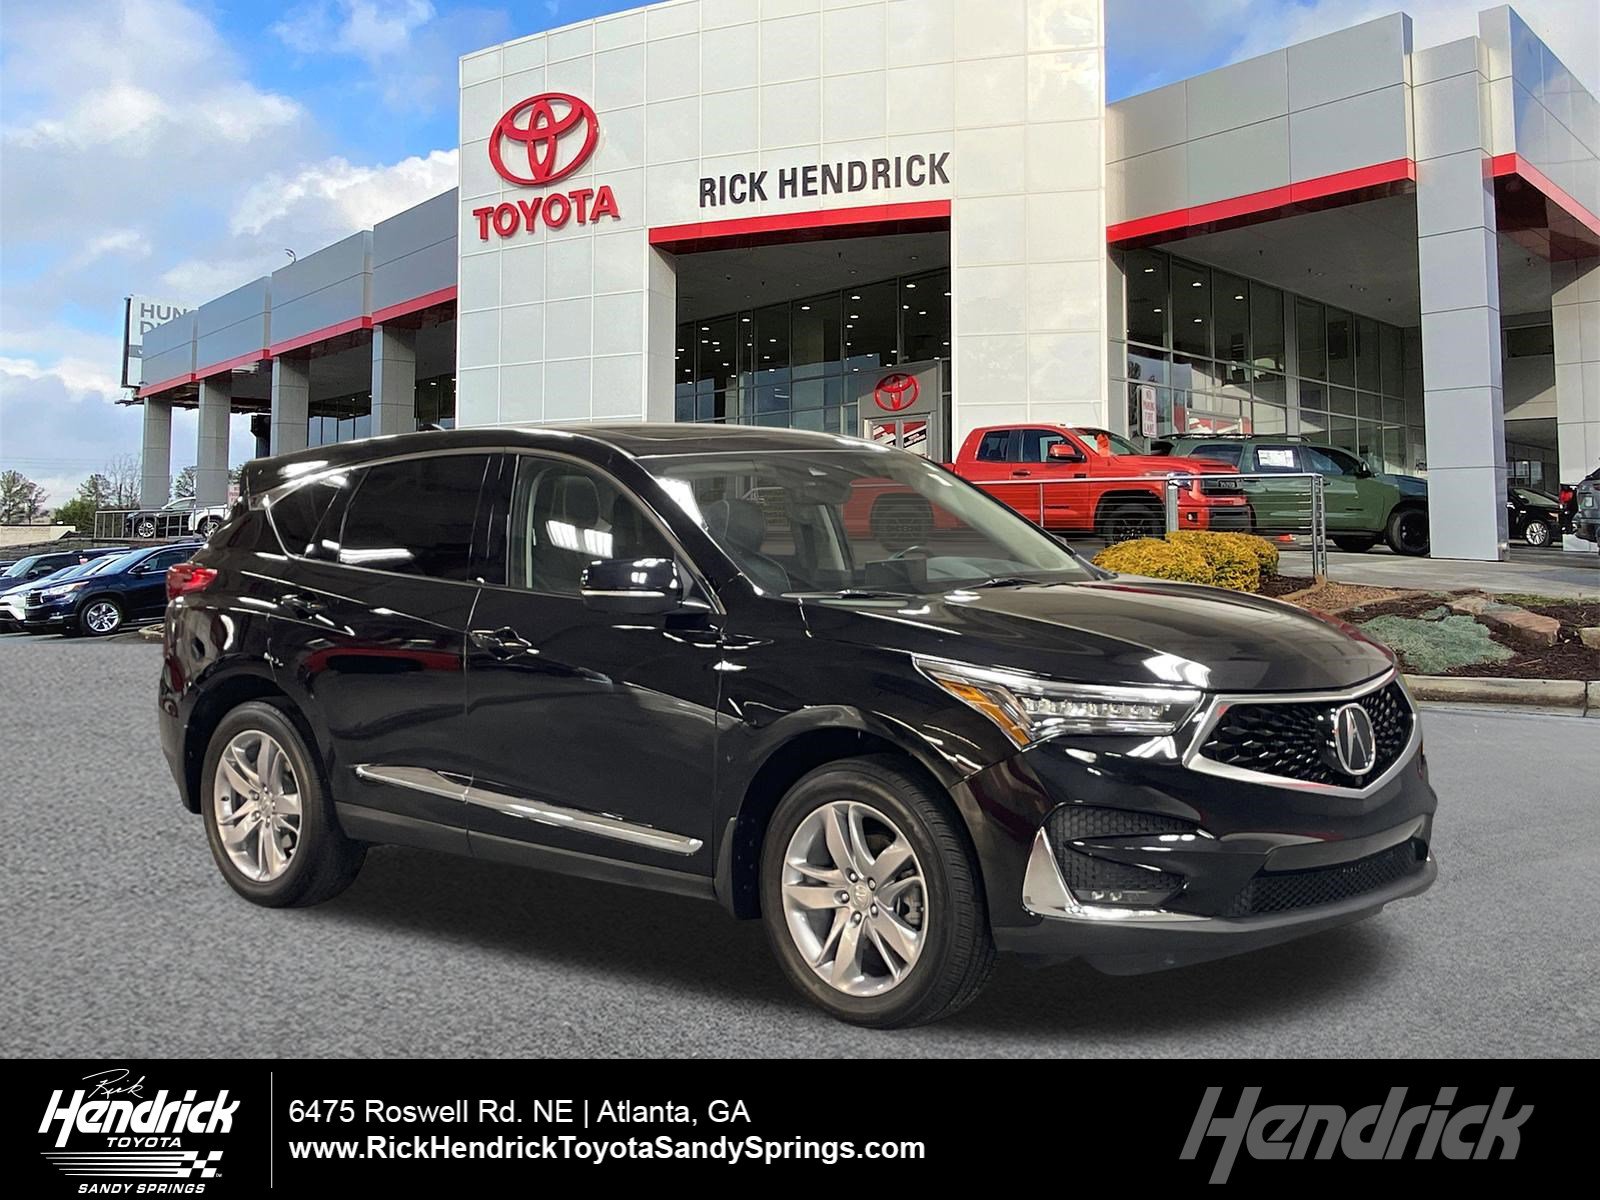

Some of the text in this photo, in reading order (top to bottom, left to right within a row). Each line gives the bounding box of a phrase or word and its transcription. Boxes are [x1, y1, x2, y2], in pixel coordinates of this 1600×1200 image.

[700, 152, 951, 208] RICK HENDRICK
[473, 186, 620, 240] TOYOTA
